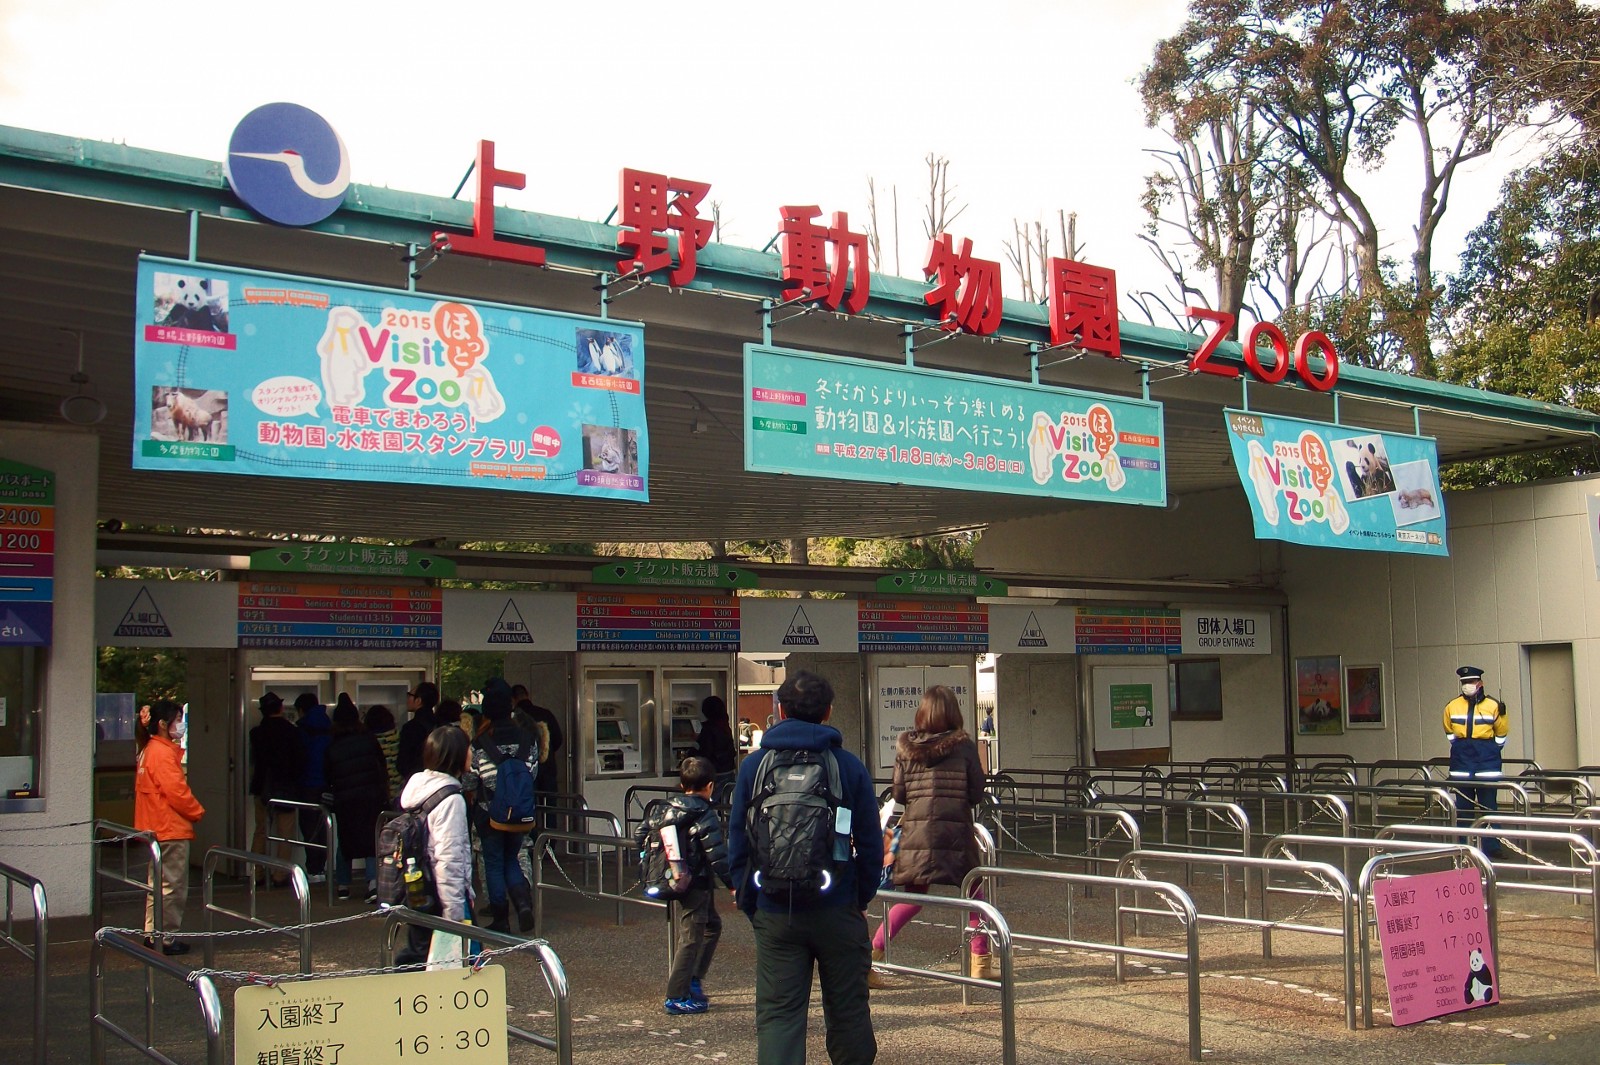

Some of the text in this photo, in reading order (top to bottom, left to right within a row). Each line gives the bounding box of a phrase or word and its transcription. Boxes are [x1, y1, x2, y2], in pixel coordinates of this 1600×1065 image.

[430, 139, 1121, 358] 上野動物園
[387, 313, 431, 331] 2015
[359, 326, 446, 367] Visit
[389, 369, 461, 405] Zoo
[815, 378, 1025, 422] 冬だからよりいっそう楽しめる
[332, 405, 476, 433] 電車でまわろう!
[1063, 416, 1086, 427] 2015
[533, 432, 560, 448] 開催中
[1049, 425, 1094, 452] Visit
[1275, 445, 1299, 459] 2015
[1065, 454, 1102, 479] Zoo
[1264, 456, 1313, 489] Visit
[1285, 491, 1324, 520] Zoo
[302, 546, 409, 566] チケット販売機
[633, 562, 720, 578] チケット販売機
[909, 572, 978, 586] チケット販売機
[409, 602, 431, 610] ¥300
[127, 612, 160, 623] 入場口
[409, 615, 431, 623] ¥200
[1198, 618, 1255, 635] 団体入場口
[118, 626, 168, 636] ENTRANCE
[491, 634, 531, 642] ENTRANCE
[1199, 637, 1255, 647] GROUP ENTRANCE
[1384, 882, 1475, 908] 入園終了 16:00
[1387, 907, 1479, 934] 観覧終了 16:30
[1390, 932, 1483, 960] 閉園時間 17:00
[258, 988, 490, 1031] 入園終了 16:00
[394, 1028, 491, 1057] 16:30
